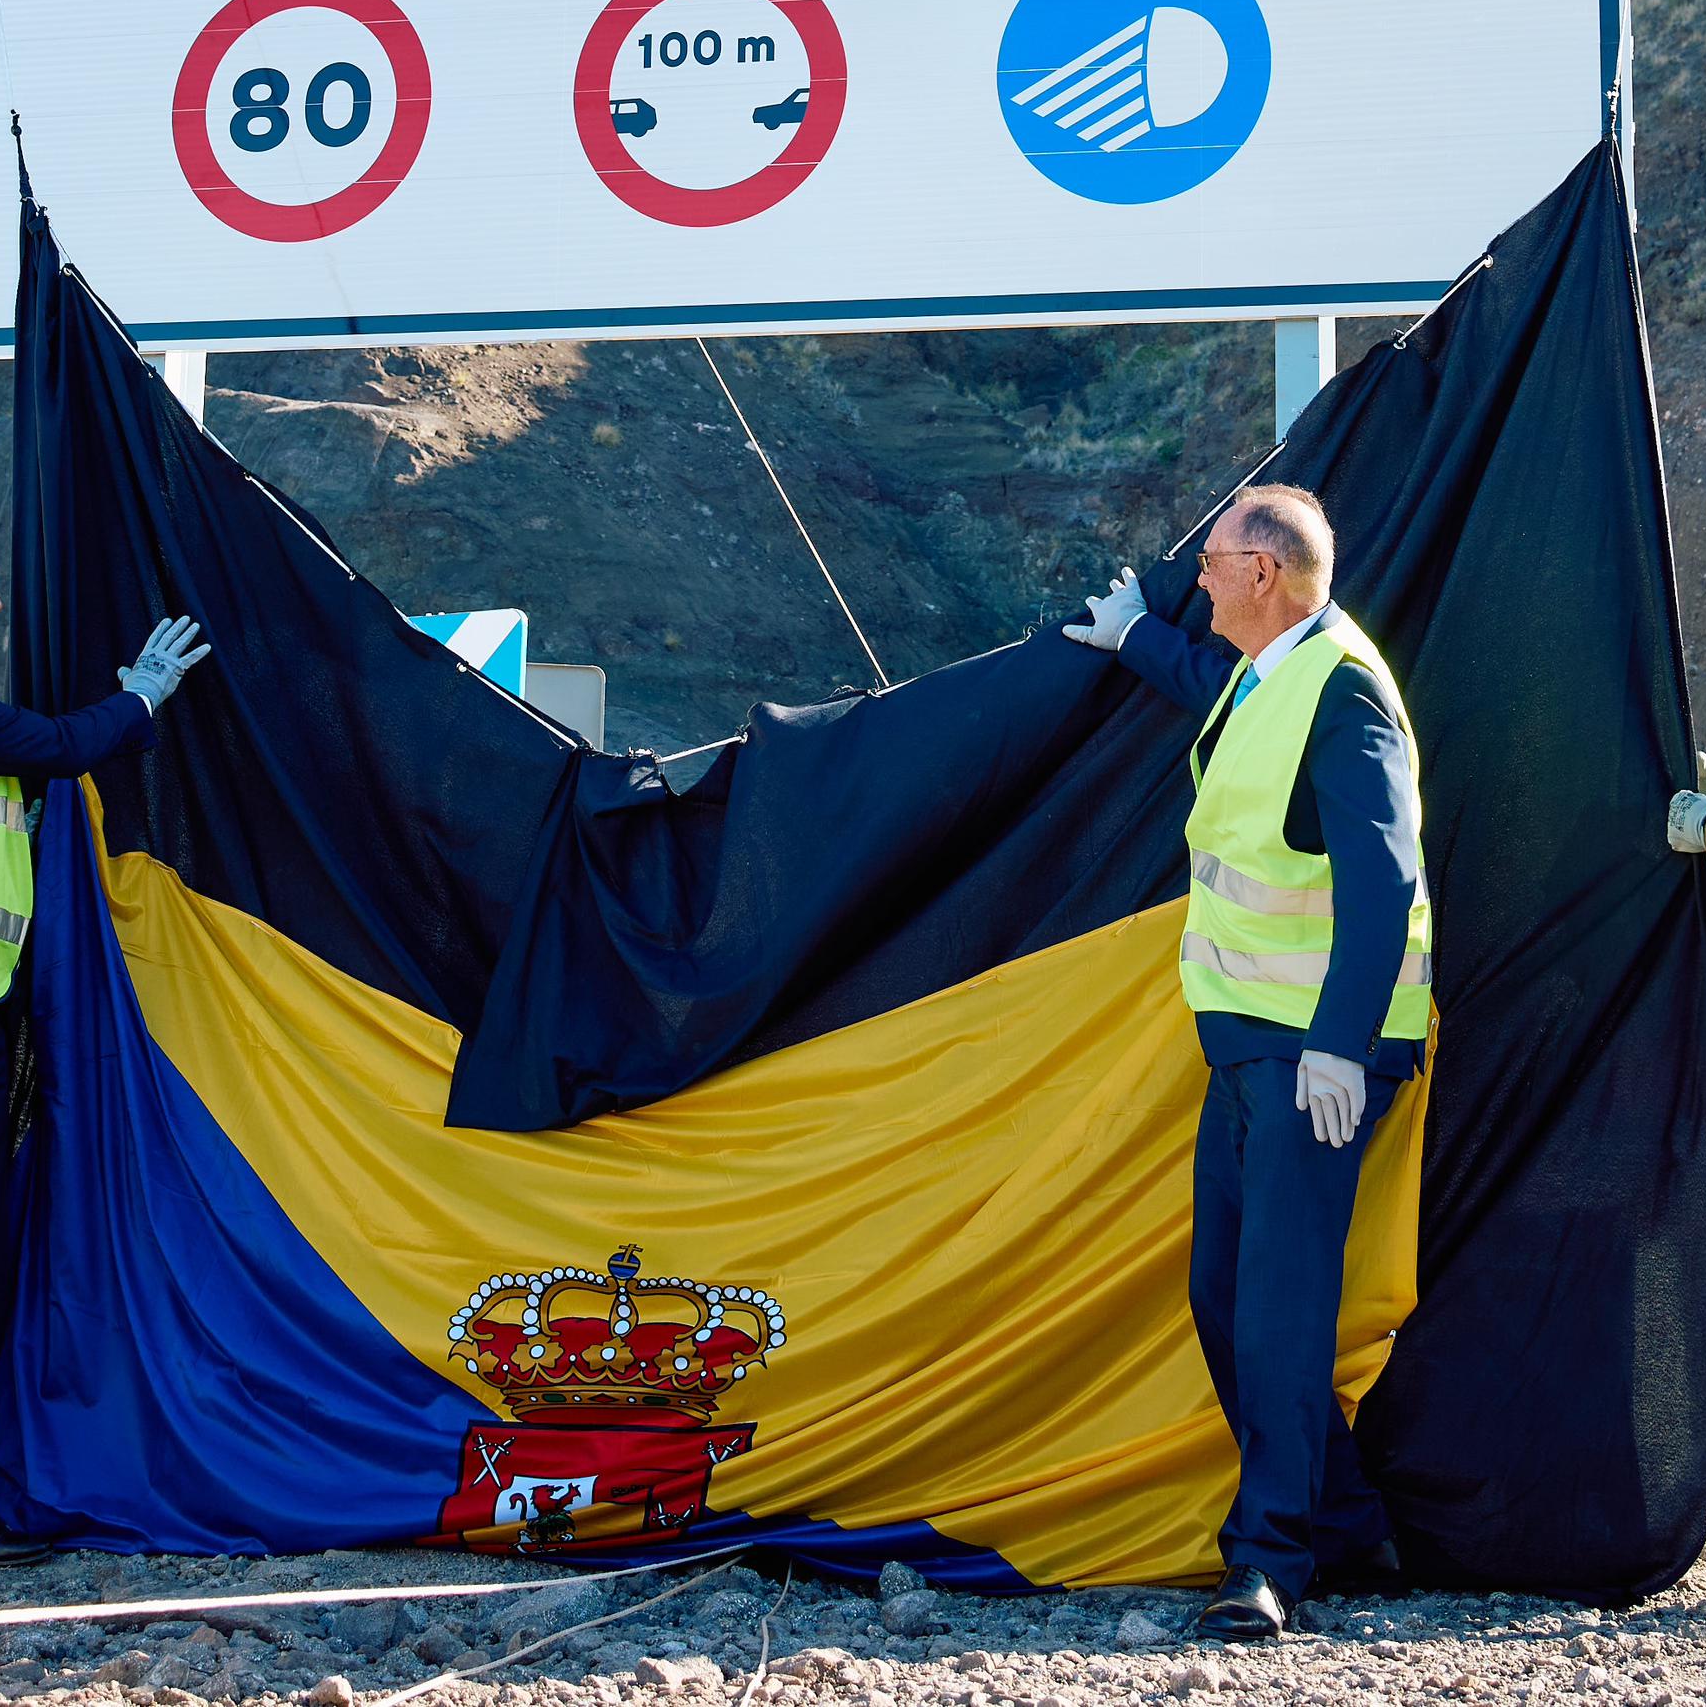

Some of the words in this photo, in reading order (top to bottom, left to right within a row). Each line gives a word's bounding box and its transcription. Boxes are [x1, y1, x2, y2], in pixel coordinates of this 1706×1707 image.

[638, 29, 722, 69] 100
[737, 35, 775, 64] m
[229, 61, 372, 153] 80
